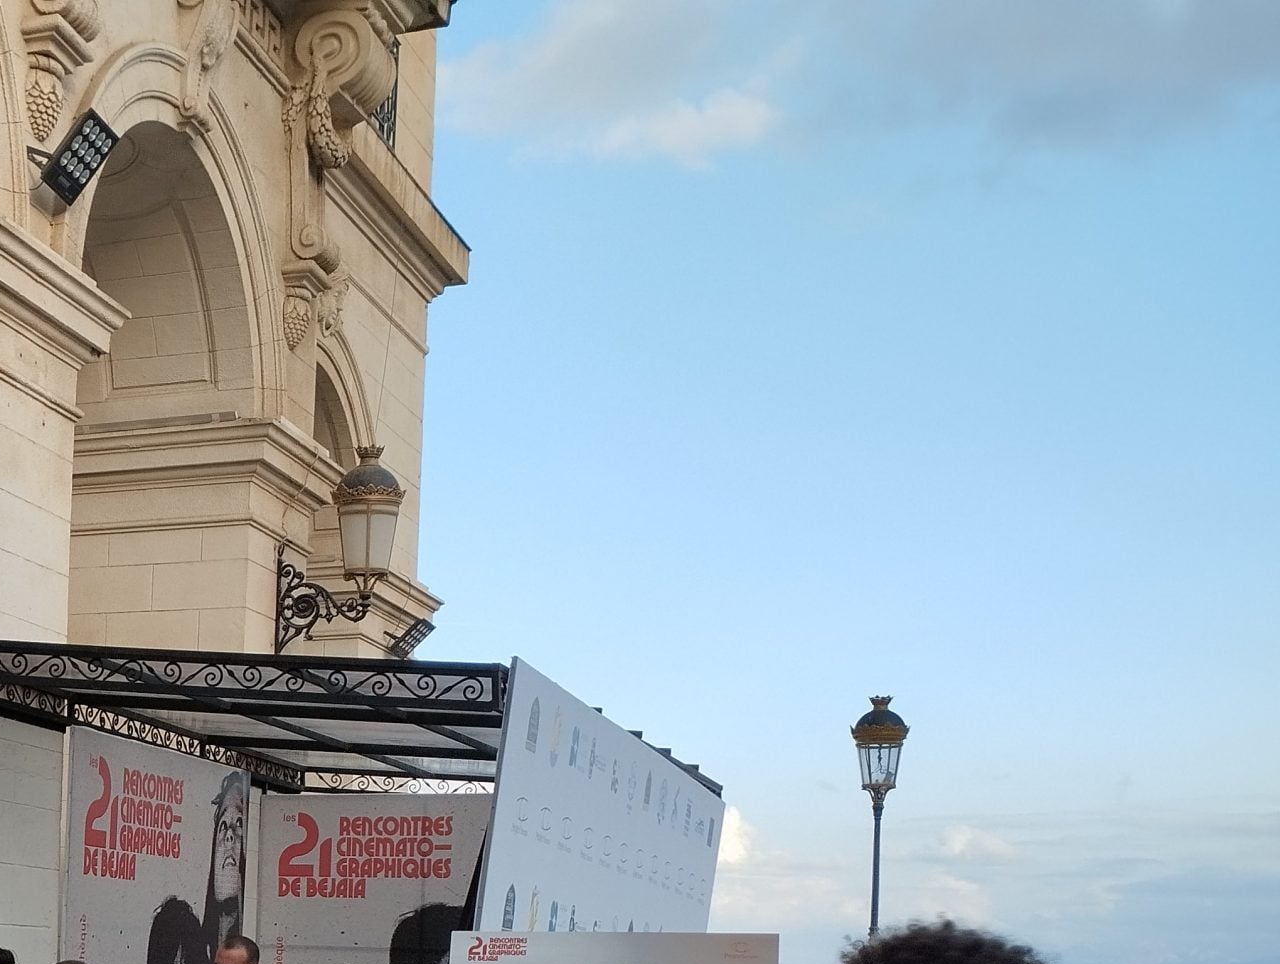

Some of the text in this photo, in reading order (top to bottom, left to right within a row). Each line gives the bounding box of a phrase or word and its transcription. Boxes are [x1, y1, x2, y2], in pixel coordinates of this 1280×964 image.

[123, 767, 185, 805] RENCONTRES
[84, 755, 120, 850] 21
[282, 812, 297, 823] les
[339, 815, 454, 837] RENCONTRES
[119, 824, 182, 859] GRAPHIQUES
[278, 811, 333, 878] 21
[83, 847, 137, 881] DE BEJAIA
[335, 857, 452, 879] GRAPHIQUES
[278, 877, 367, 898] DE BEJAIA
[468, 936, 487, 956] 21
